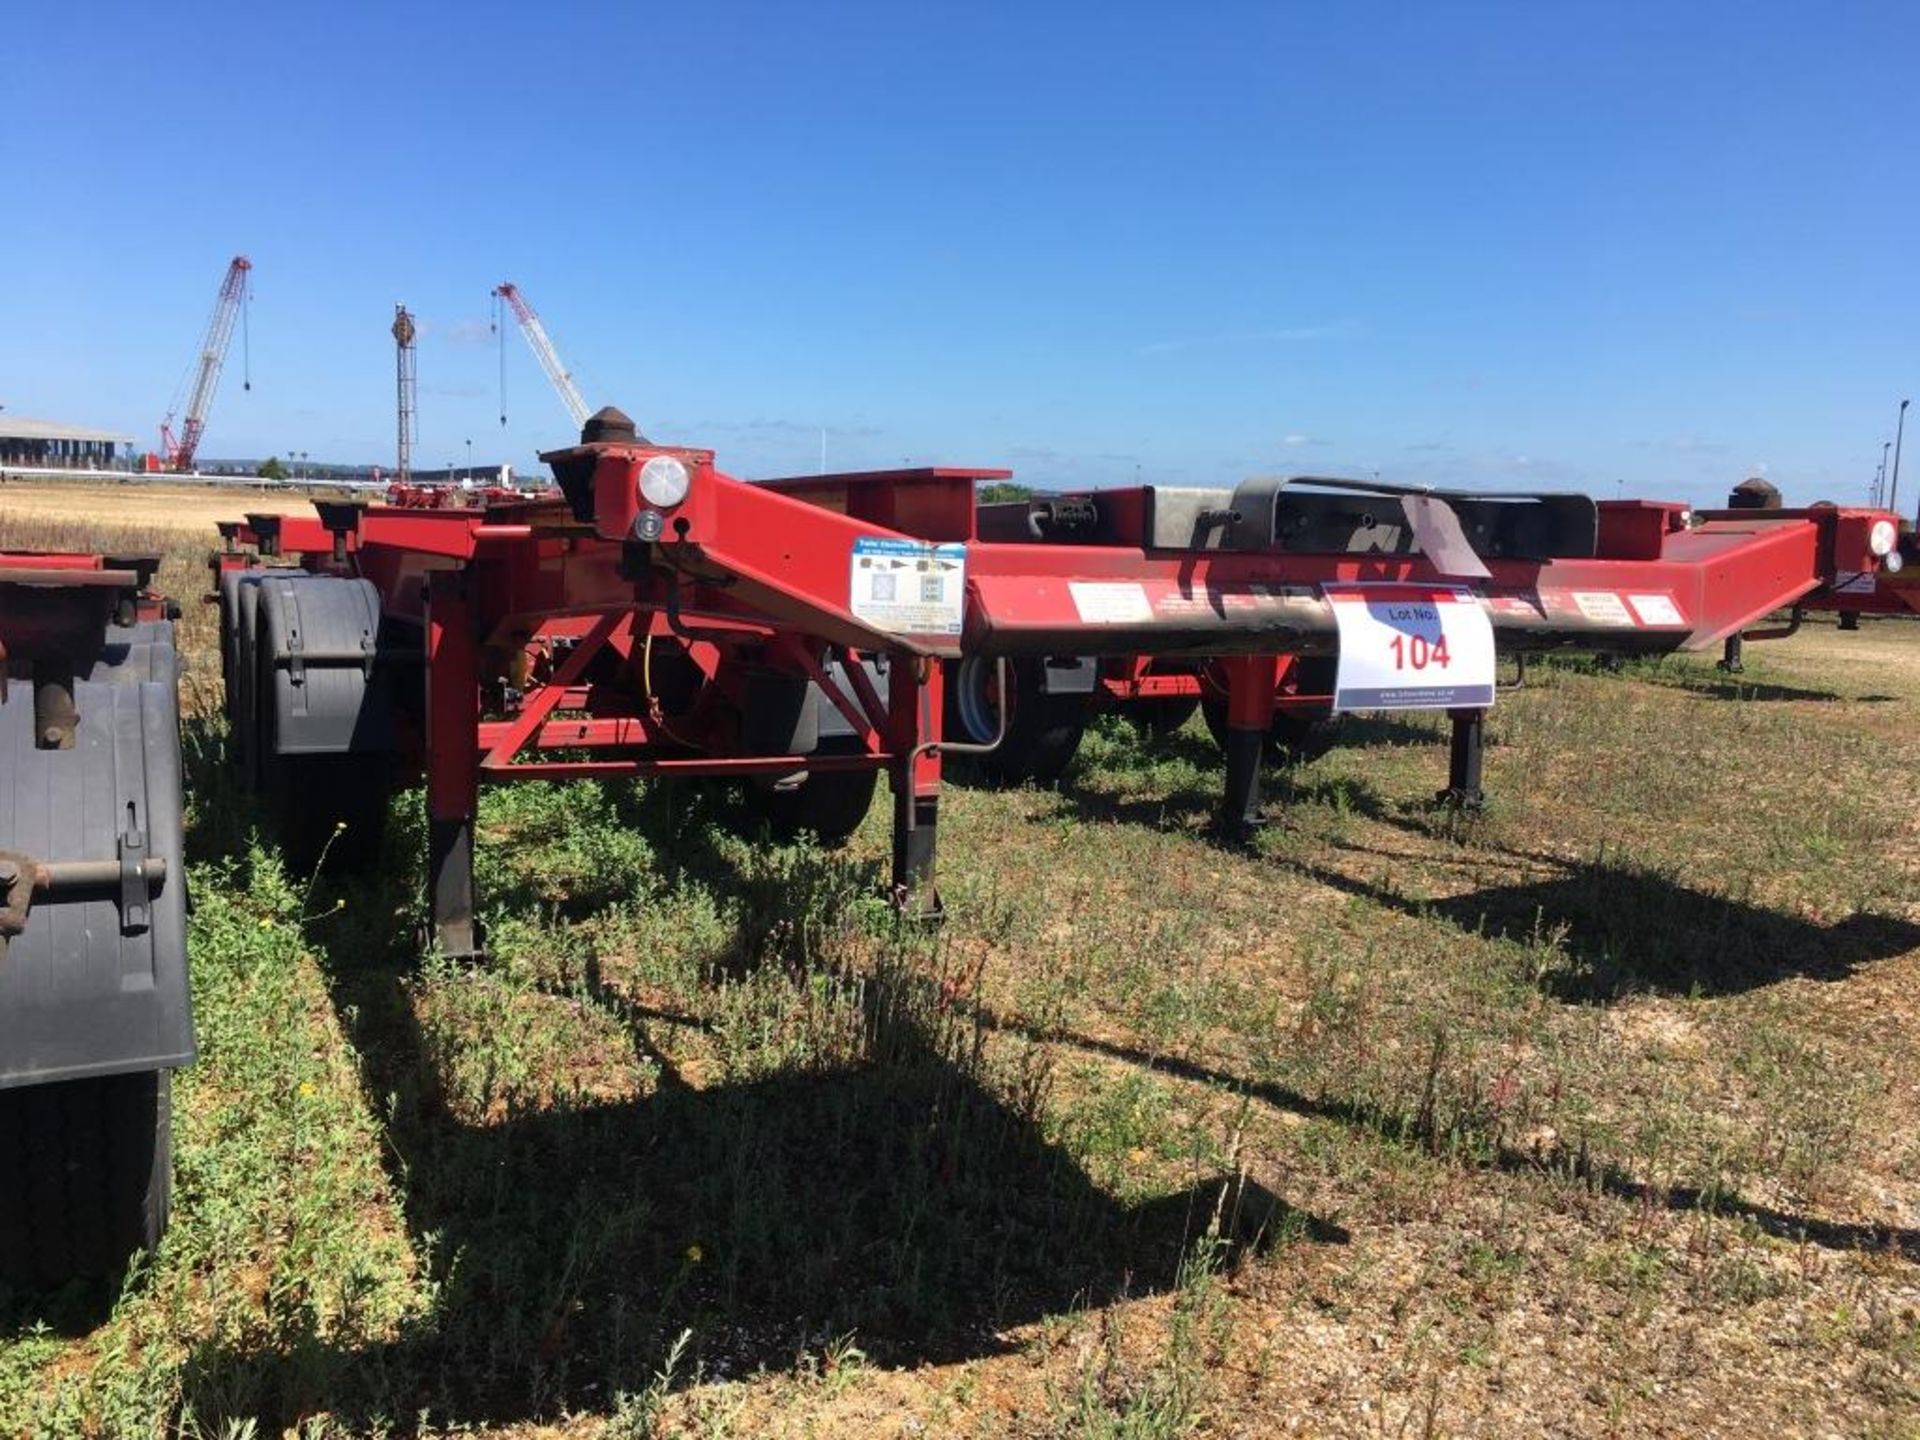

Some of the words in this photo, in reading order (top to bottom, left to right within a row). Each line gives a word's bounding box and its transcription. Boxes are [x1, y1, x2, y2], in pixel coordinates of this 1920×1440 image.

[1388, 609, 1412, 621] Lot
[1415, 608, 1437, 620] No.
[1390, 633, 1451, 670] 104
